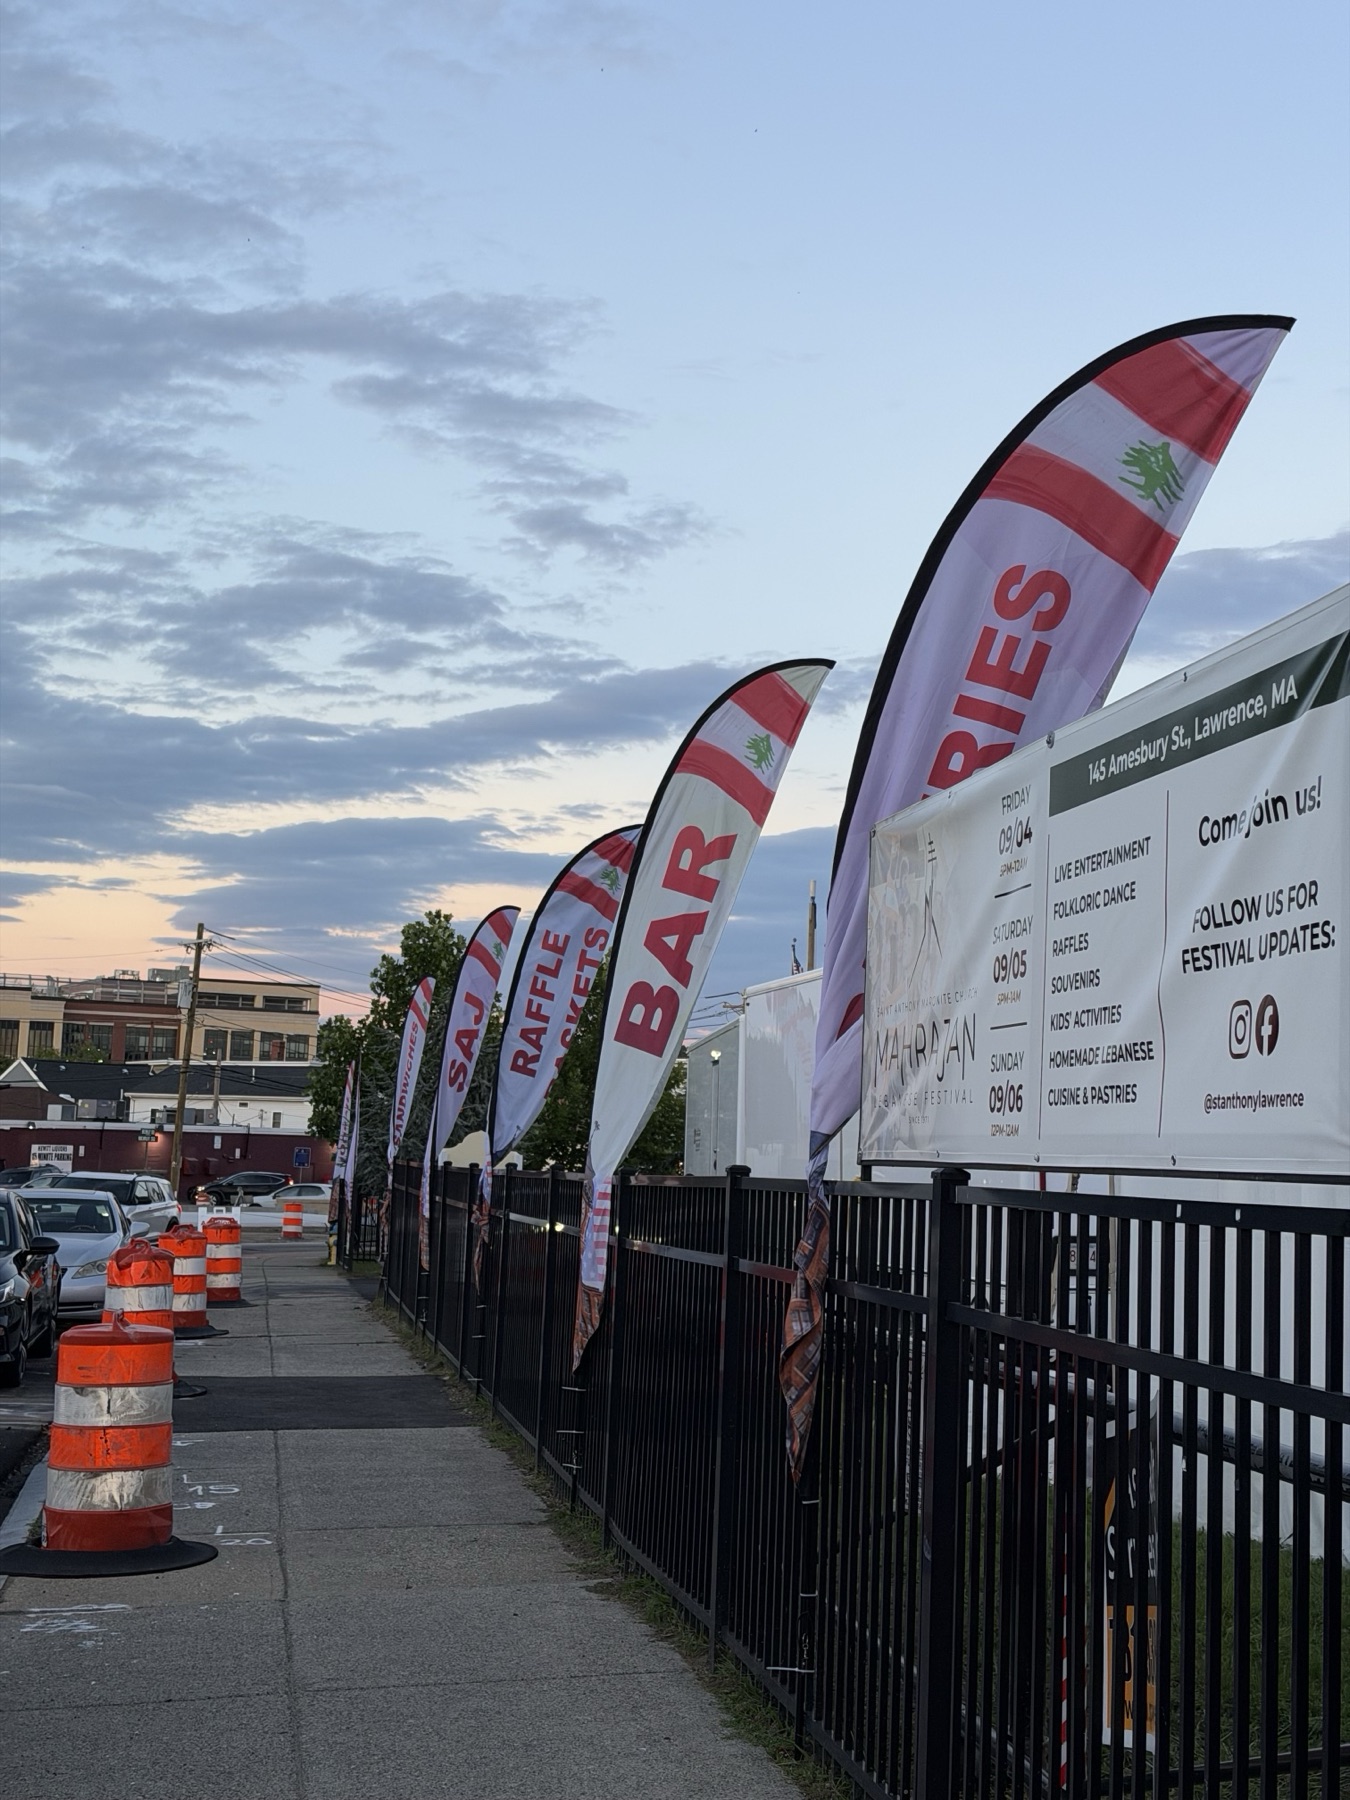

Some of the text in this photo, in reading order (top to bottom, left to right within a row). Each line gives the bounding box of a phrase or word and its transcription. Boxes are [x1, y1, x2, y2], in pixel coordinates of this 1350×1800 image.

[921, 564, 1072, 801] RIES
[1088, 674, 1298, 785] 145 Amesbury St., Lawrence, MA
[1001, 784, 1032, 817] FRIDAY
[1198, 775, 1322, 847] Come join us!
[999, 816, 1033, 856] 09/04
[1054, 836, 1152, 884] LIVE ENTERTAINMENT
[1053, 881, 1137, 920] FOLKLORIC DANCE
[1192, 880, 1319, 933] FOLLOW US FOR
[613, 825, 738, 1058] BAR
[993, 915, 1034, 946] SATURDAY
[1052, 932, 1089, 958] RAFFLES
[1181, 920, 1336, 974] FESTIVAL UPDATES:
[993, 946, 1027, 983] 09/05
[1051, 968, 1100, 995] SOUVENIRS
[510, 929, 571, 1078] RAFFLE
[544, 927, 609, 1099] SKETS
[1050, 1004, 1122, 1032] KIDS' ACTIVITIES
[448, 991, 485, 1093] SAJ
[874, 1012, 976, 1088] MAHRAJAN
[1049, 1040, 1155, 1069] HOMEMADE LEBANESE
[990, 1051, 1024, 1074] SUNDAY
[392, 1021, 418, 1147] SANDWICHES
[923, 1088, 974, 1106] FESTIVAL
[989, 1080, 1023, 1117] 09/06
[1047, 1083, 1138, 1107] CUISINE & PASTRIES
[1203, 1089, 1305, 1114] @stanthonylawrence
[990, 1123, 1020, 1138] 12PM-12AM
